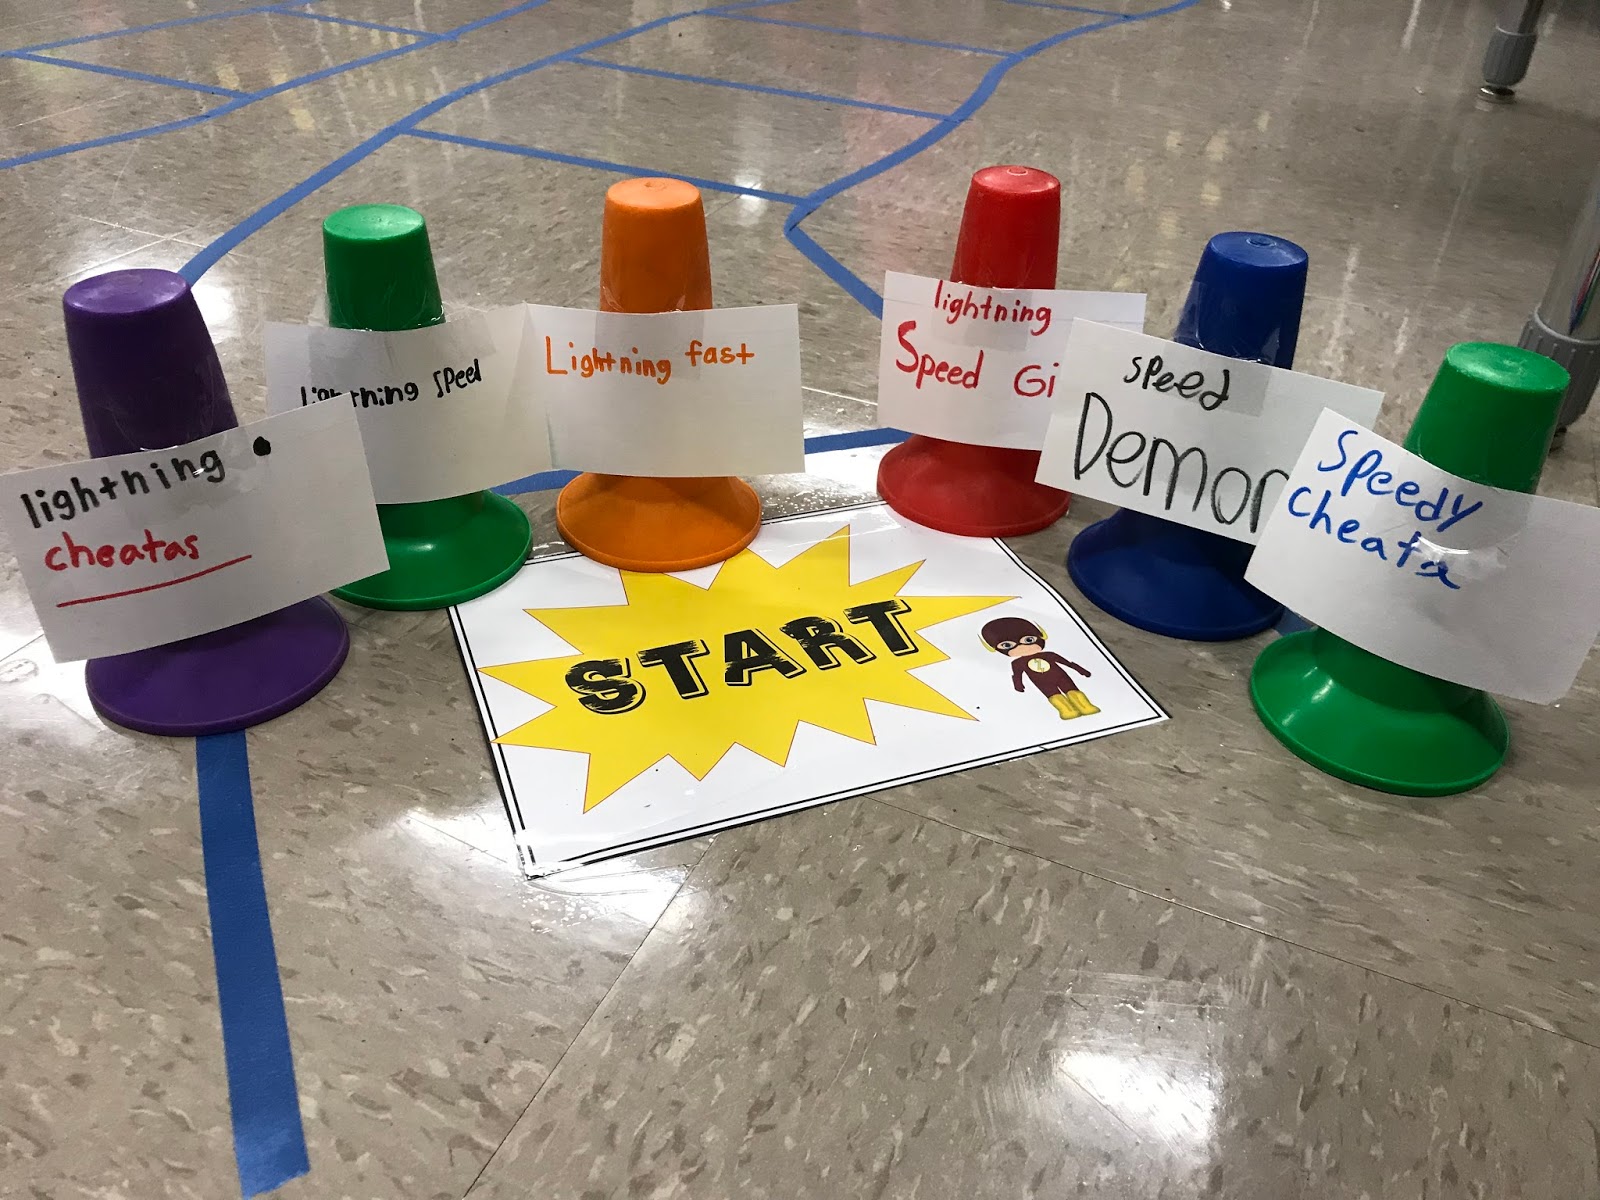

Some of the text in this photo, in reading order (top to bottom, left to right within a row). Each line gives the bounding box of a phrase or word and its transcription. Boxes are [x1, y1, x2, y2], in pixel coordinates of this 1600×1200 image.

[935, 279, 1052, 336] lightning
[545, 335, 755, 385] Lightning fast
[895, 320, 984, 389] Speed
[20, 449, 226, 529] lightning
[44, 529, 200, 572] cheatas
[564, 599, 919, 715] START
